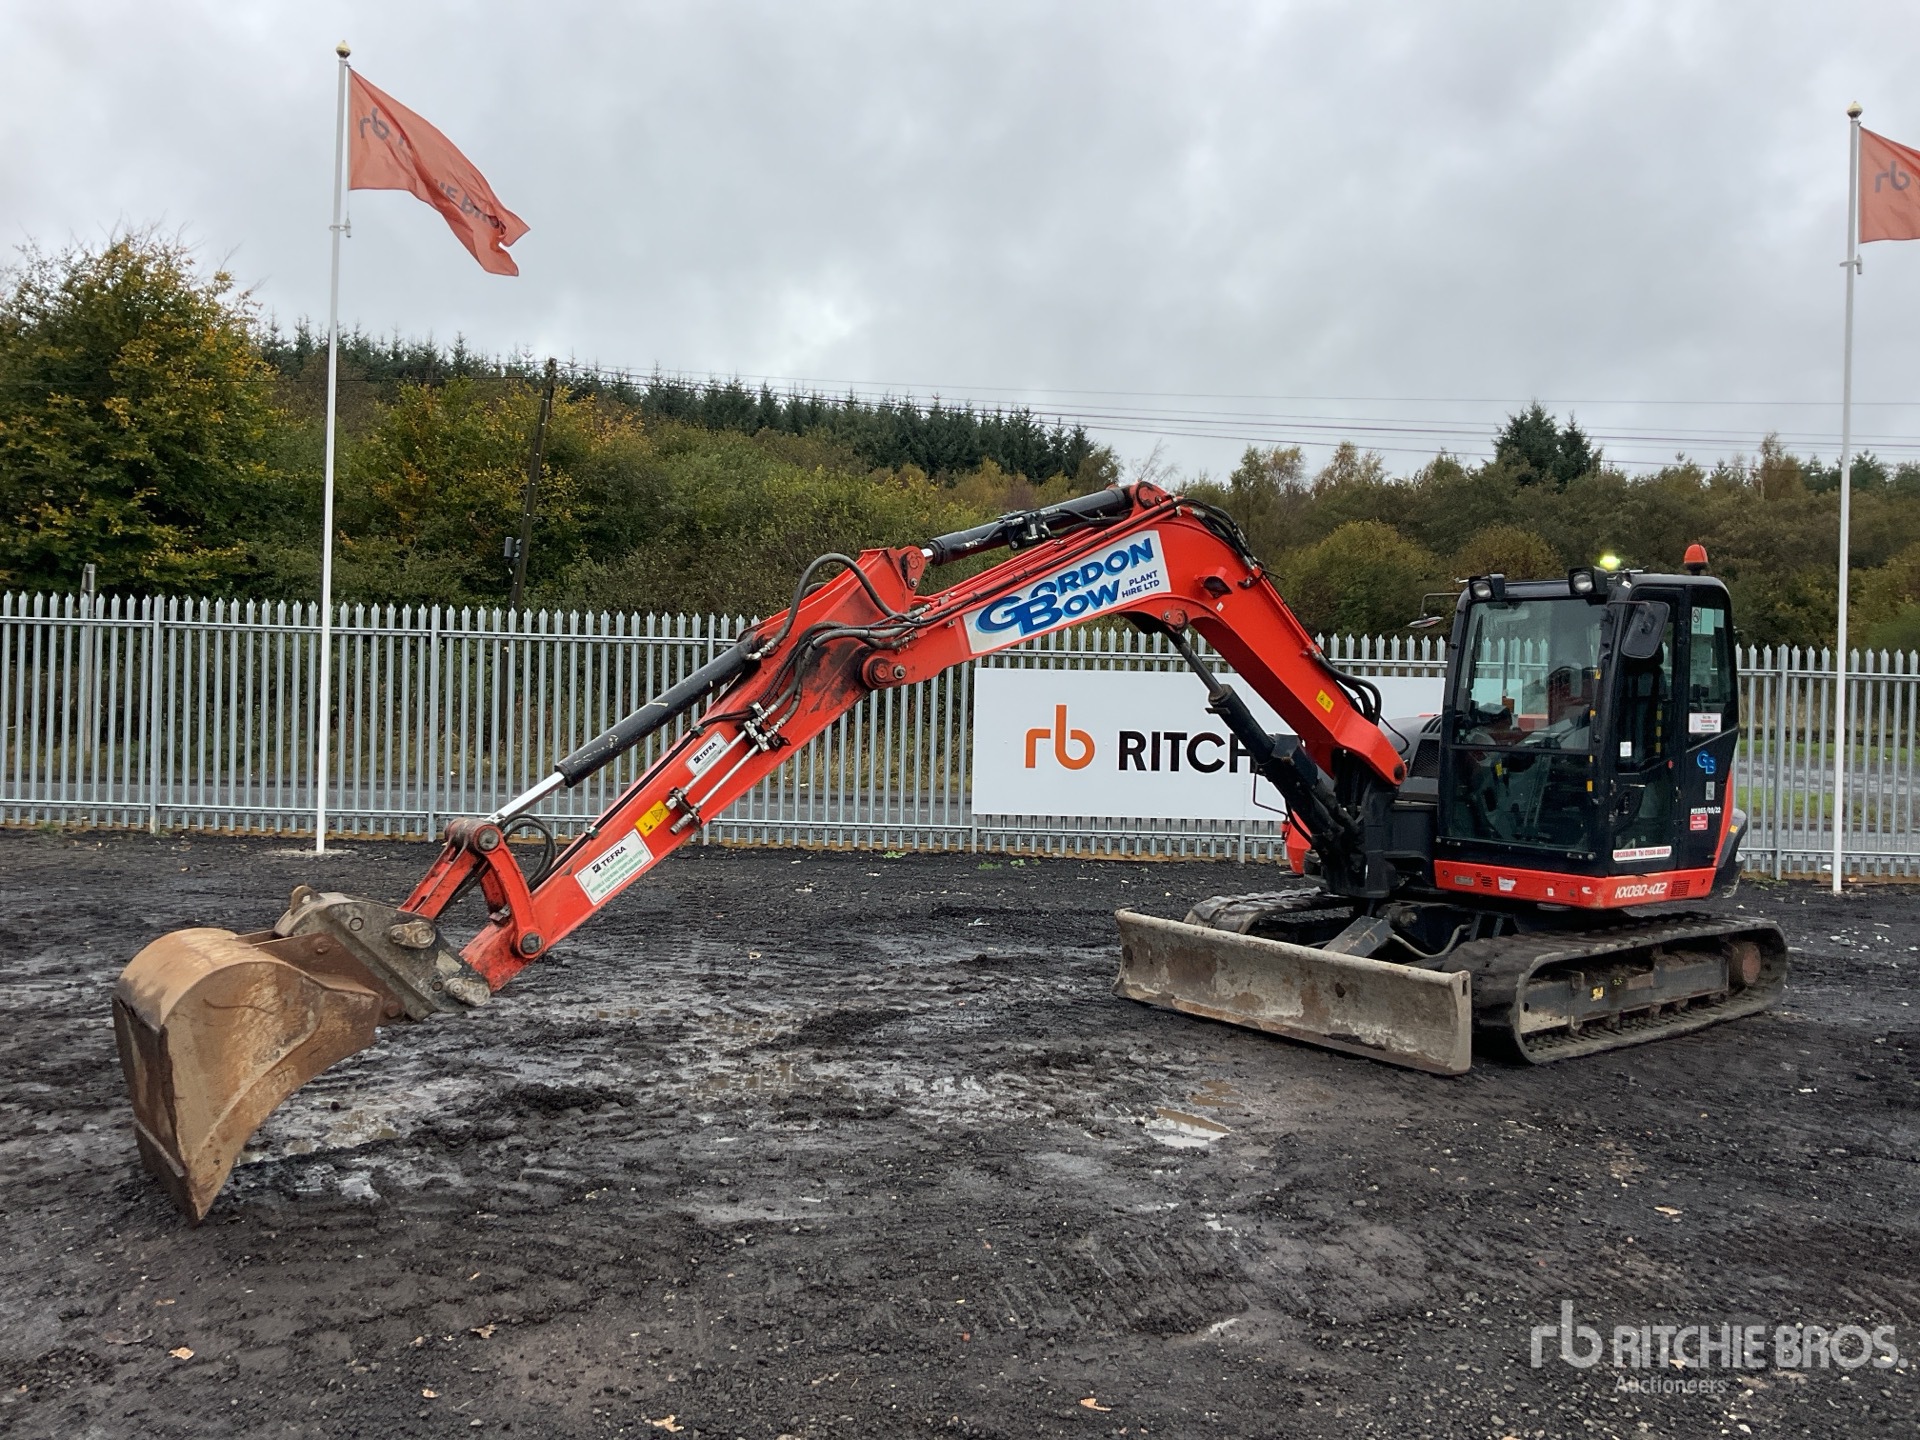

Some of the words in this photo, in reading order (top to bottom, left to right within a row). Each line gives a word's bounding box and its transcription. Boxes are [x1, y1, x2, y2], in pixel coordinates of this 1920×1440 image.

[360, 107, 390, 140] rb
[1875, 160, 1911, 193] rb
[975, 537, 1155, 634] GORDON
[1121, 585, 1143, 598] HIRE
[1143, 579, 1160, 592] LTD
[1129, 570, 1158, 587] PLANT
[1018, 579, 1121, 637] BOW
[700, 741, 717, 760] TEFRA
[1025, 704, 1096, 770] rb
[600, 846, 627, 867] TEFRA
